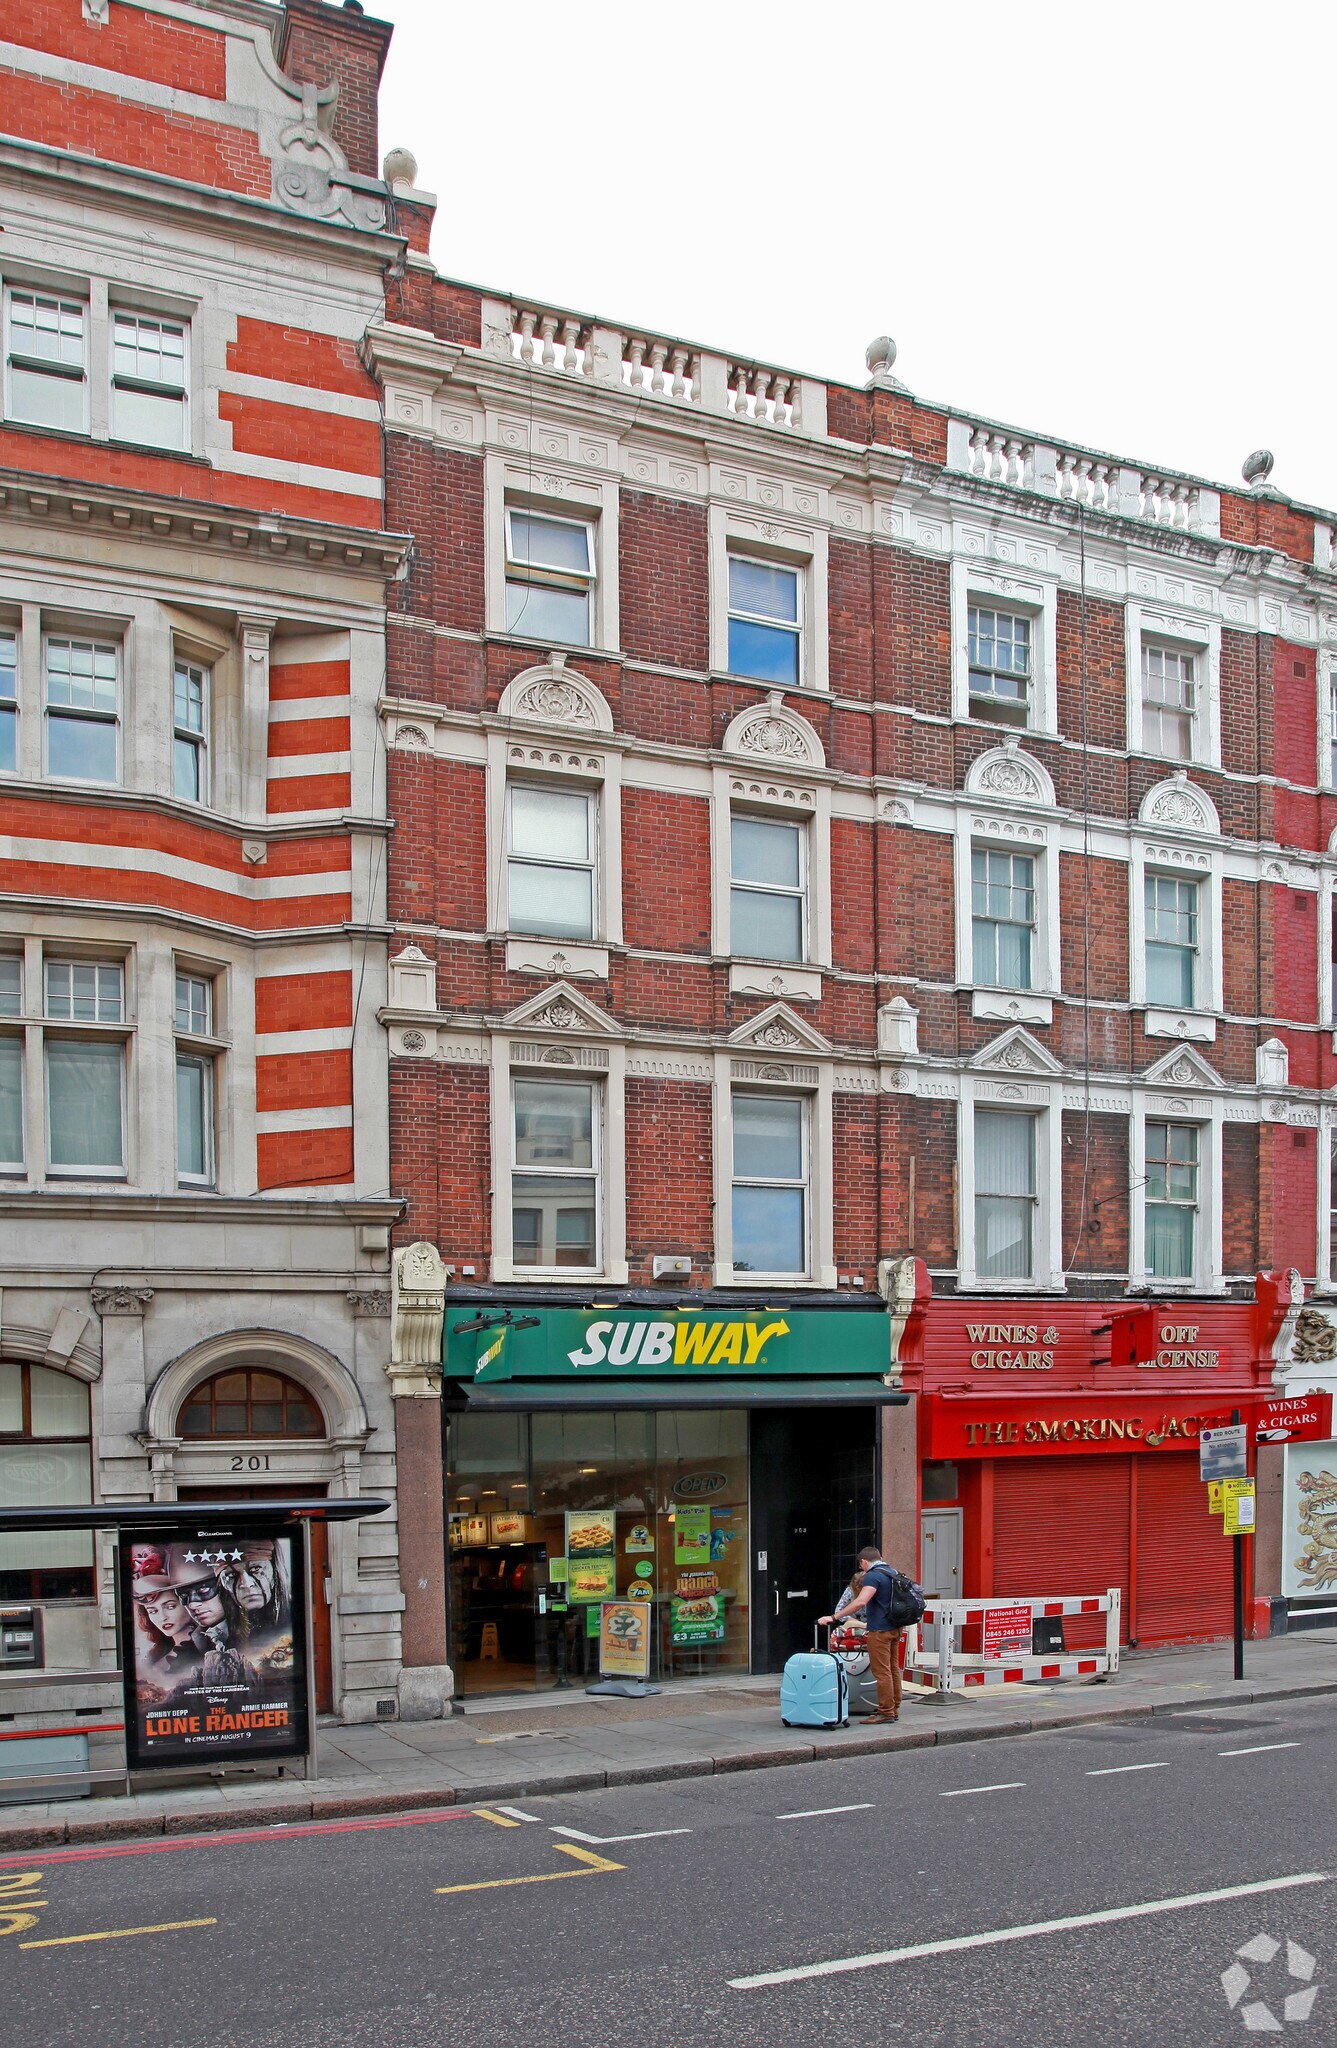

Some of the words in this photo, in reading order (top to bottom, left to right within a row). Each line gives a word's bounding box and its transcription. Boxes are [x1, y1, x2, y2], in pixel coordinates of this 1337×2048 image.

[965, 1325, 1038, 1345] WINES
[1043, 1326, 1060, 1345] &
[1161, 1325, 1200, 1343] OFF
[567, 1318, 791, 1369] SUBWAY
[475, 1335, 505, 1375] SUBWAY
[971, 1350, 1054, 1370] CIGARS
[1137, 1350, 1220, 1368] CENSE
[1267, 1399, 1308, 1413] WINES
[1257, 1420, 1267, 1429] &
[1270, 1412, 1318, 1428] CIGARS
[963, 1421, 1019, 1445] THE
[1024, 1417, 1144, 1443] SMOKING
[1224, 1428, 1241, 1436] ROUTE
[231, 1455, 270, 1471] 201
[681, 1478, 718, 1492] OPEN
[630, 1588, 650, 1597] 7AM
[988, 1610, 1014, 1618] National
[607, 1615, 642, 1636] £2
[673, 1632, 688, 1641] £3
[986, 1630, 1002, 1638] 0845
[206, 1696, 228, 1704] Disney
[241, 1704, 260, 1712] ARMIE
[261, 1702, 288, 1710] HAMMER
[146, 1710, 171, 1719] JOHNNY
[172, 1709, 188, 1717] DEPP
[210, 1706, 226, 1715] THE
[146, 1716, 200, 1736] LONE
[206, 1710, 289, 1732] RANGER
[192, 1734, 219, 1743] CINEMAS
[220, 1732, 244, 1741] AUGUST
